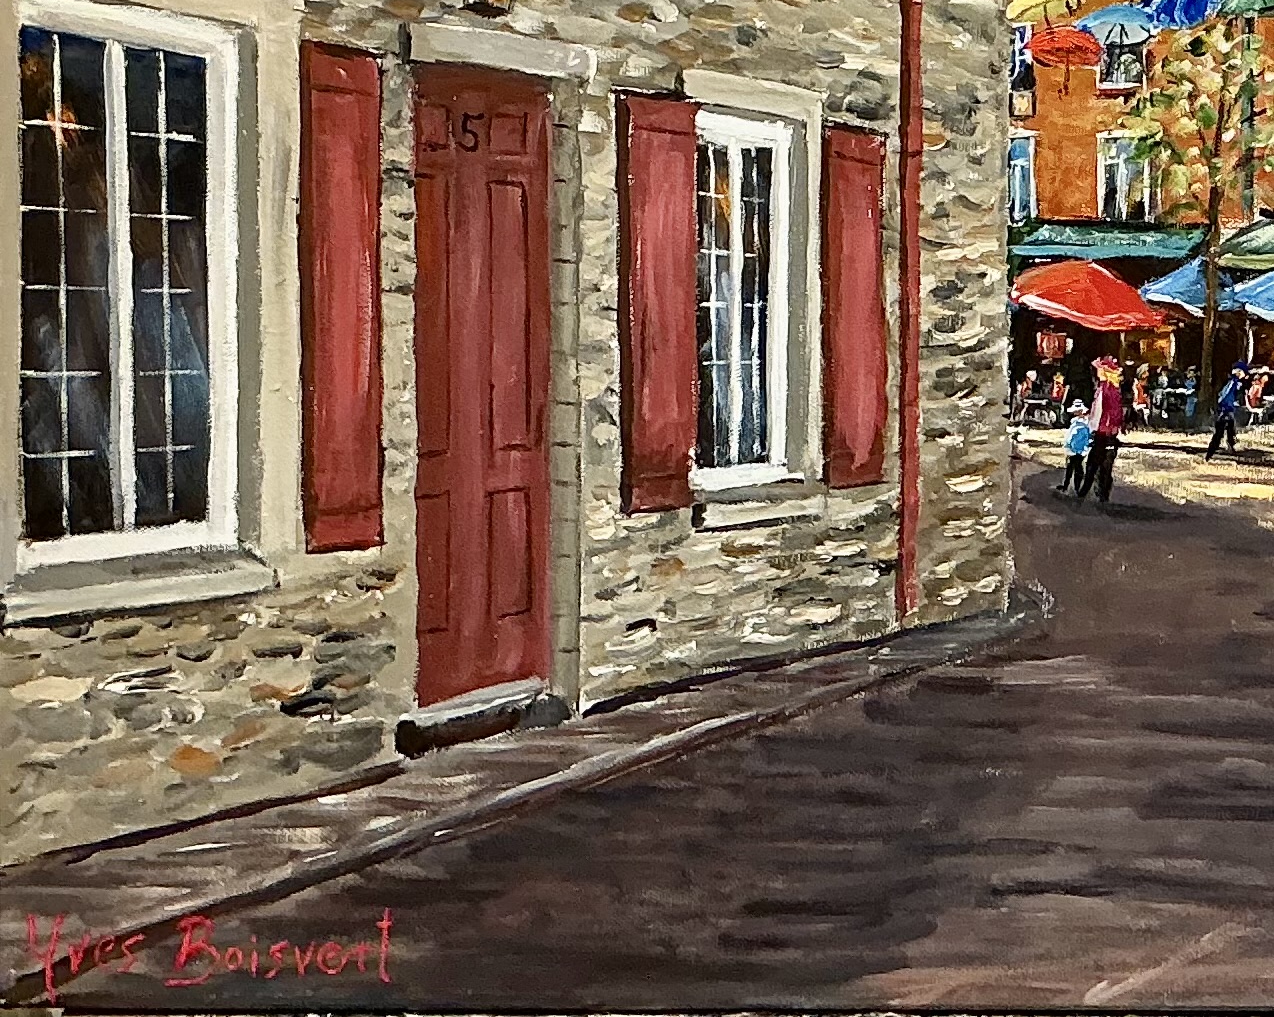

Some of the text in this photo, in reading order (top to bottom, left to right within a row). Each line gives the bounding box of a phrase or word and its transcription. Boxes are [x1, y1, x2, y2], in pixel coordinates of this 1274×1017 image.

[455, 111, 485, 153] 5
[26, 906, 393, 1006] Yves Boisvert
